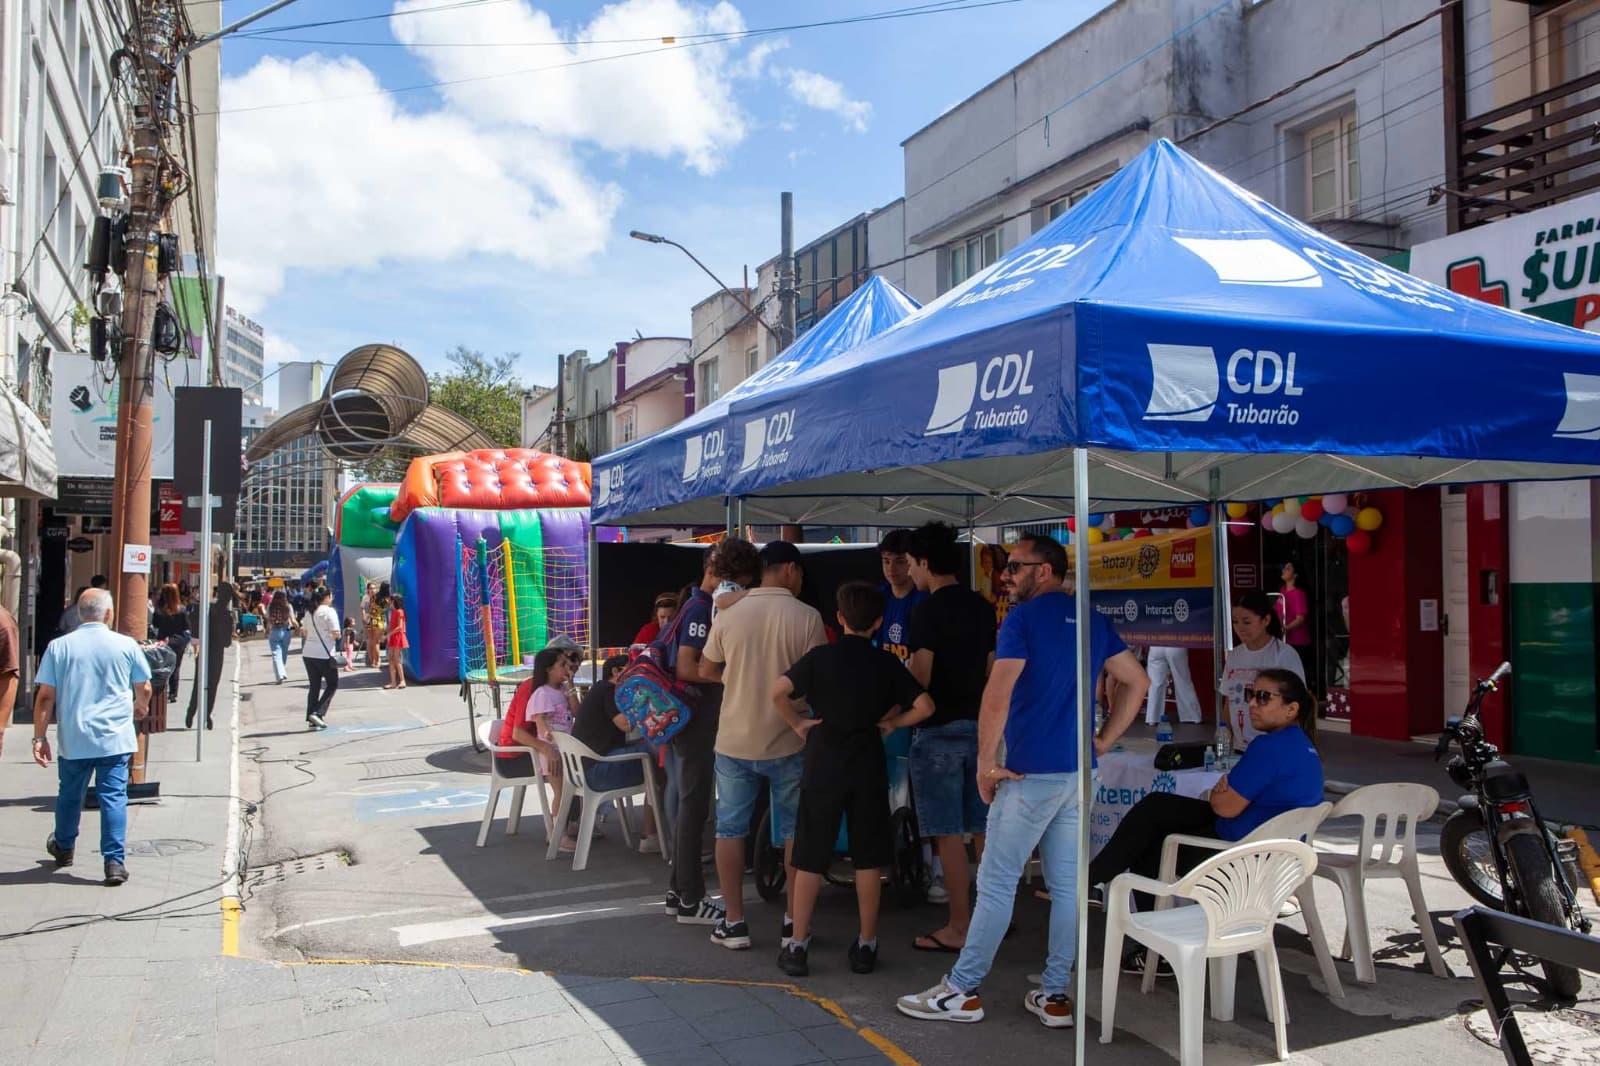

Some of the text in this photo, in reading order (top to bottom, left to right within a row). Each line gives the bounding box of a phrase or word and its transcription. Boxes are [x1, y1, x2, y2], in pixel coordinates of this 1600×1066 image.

[985, 236, 1097, 285] CDL
[1303, 247, 1430, 298] CDL
[979, 349, 1034, 402] CDL
[1226, 348, 1304, 396] CDL
[974, 404, 1028, 430] Tubarão
[1226, 402, 1300, 426] Tubarão
[766, 408, 796, 447] CDL
[703, 428, 725, 460] CDL
[761, 449, 789, 469] Tubarão
[610, 463, 625, 490] CDL
[1102, 555, 1136, 572] Rotary
[1171, 552, 1194, 564] POLIO
[1145, 604, 1174, 616] Interact
[689, 622, 706, 637] 86
